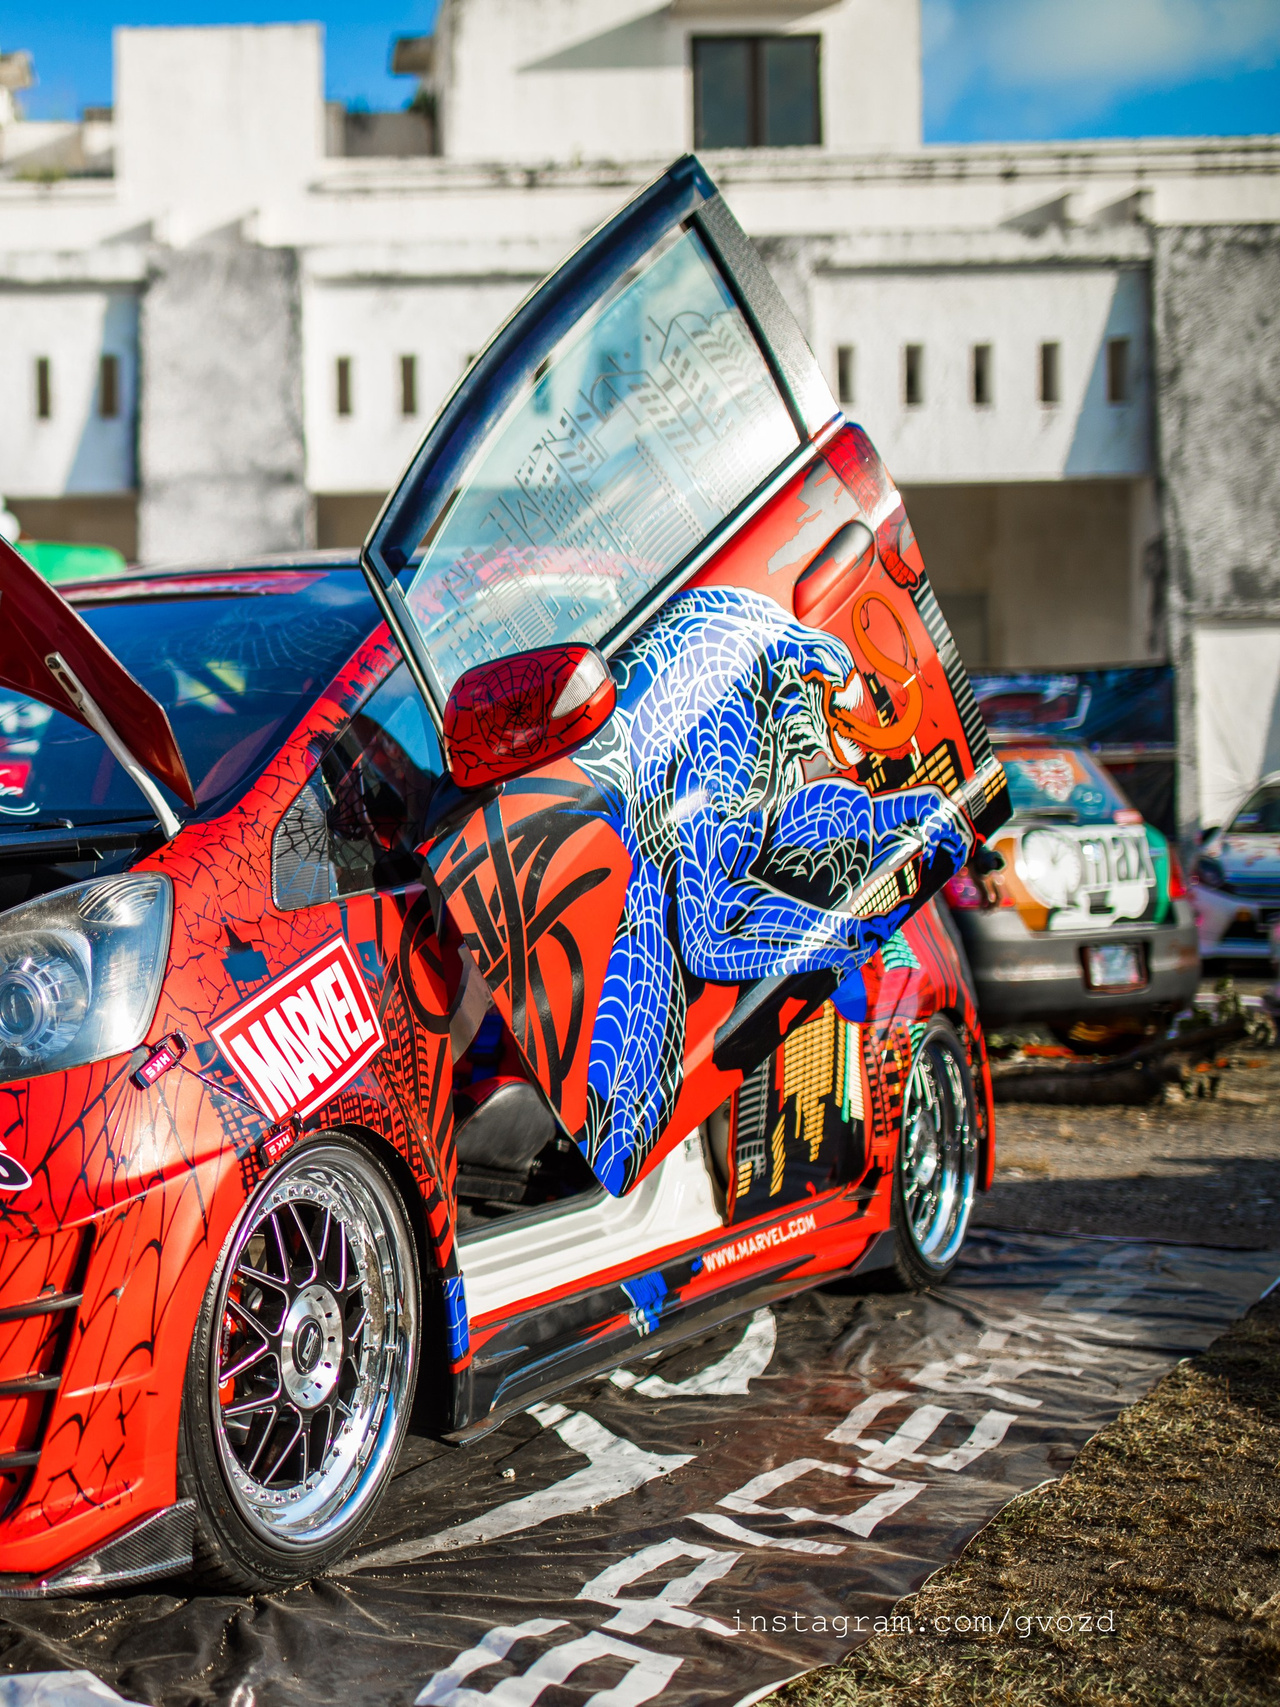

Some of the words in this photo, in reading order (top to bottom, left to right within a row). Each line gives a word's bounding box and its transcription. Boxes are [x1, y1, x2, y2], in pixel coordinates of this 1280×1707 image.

[235, 960, 375, 1118] MARVEL
[145, 1053, 171, 1079] HKS
[268, 1134, 291, 1156] HKS
[702, 1213, 816, 1273] WWW.MARVEL.COM
